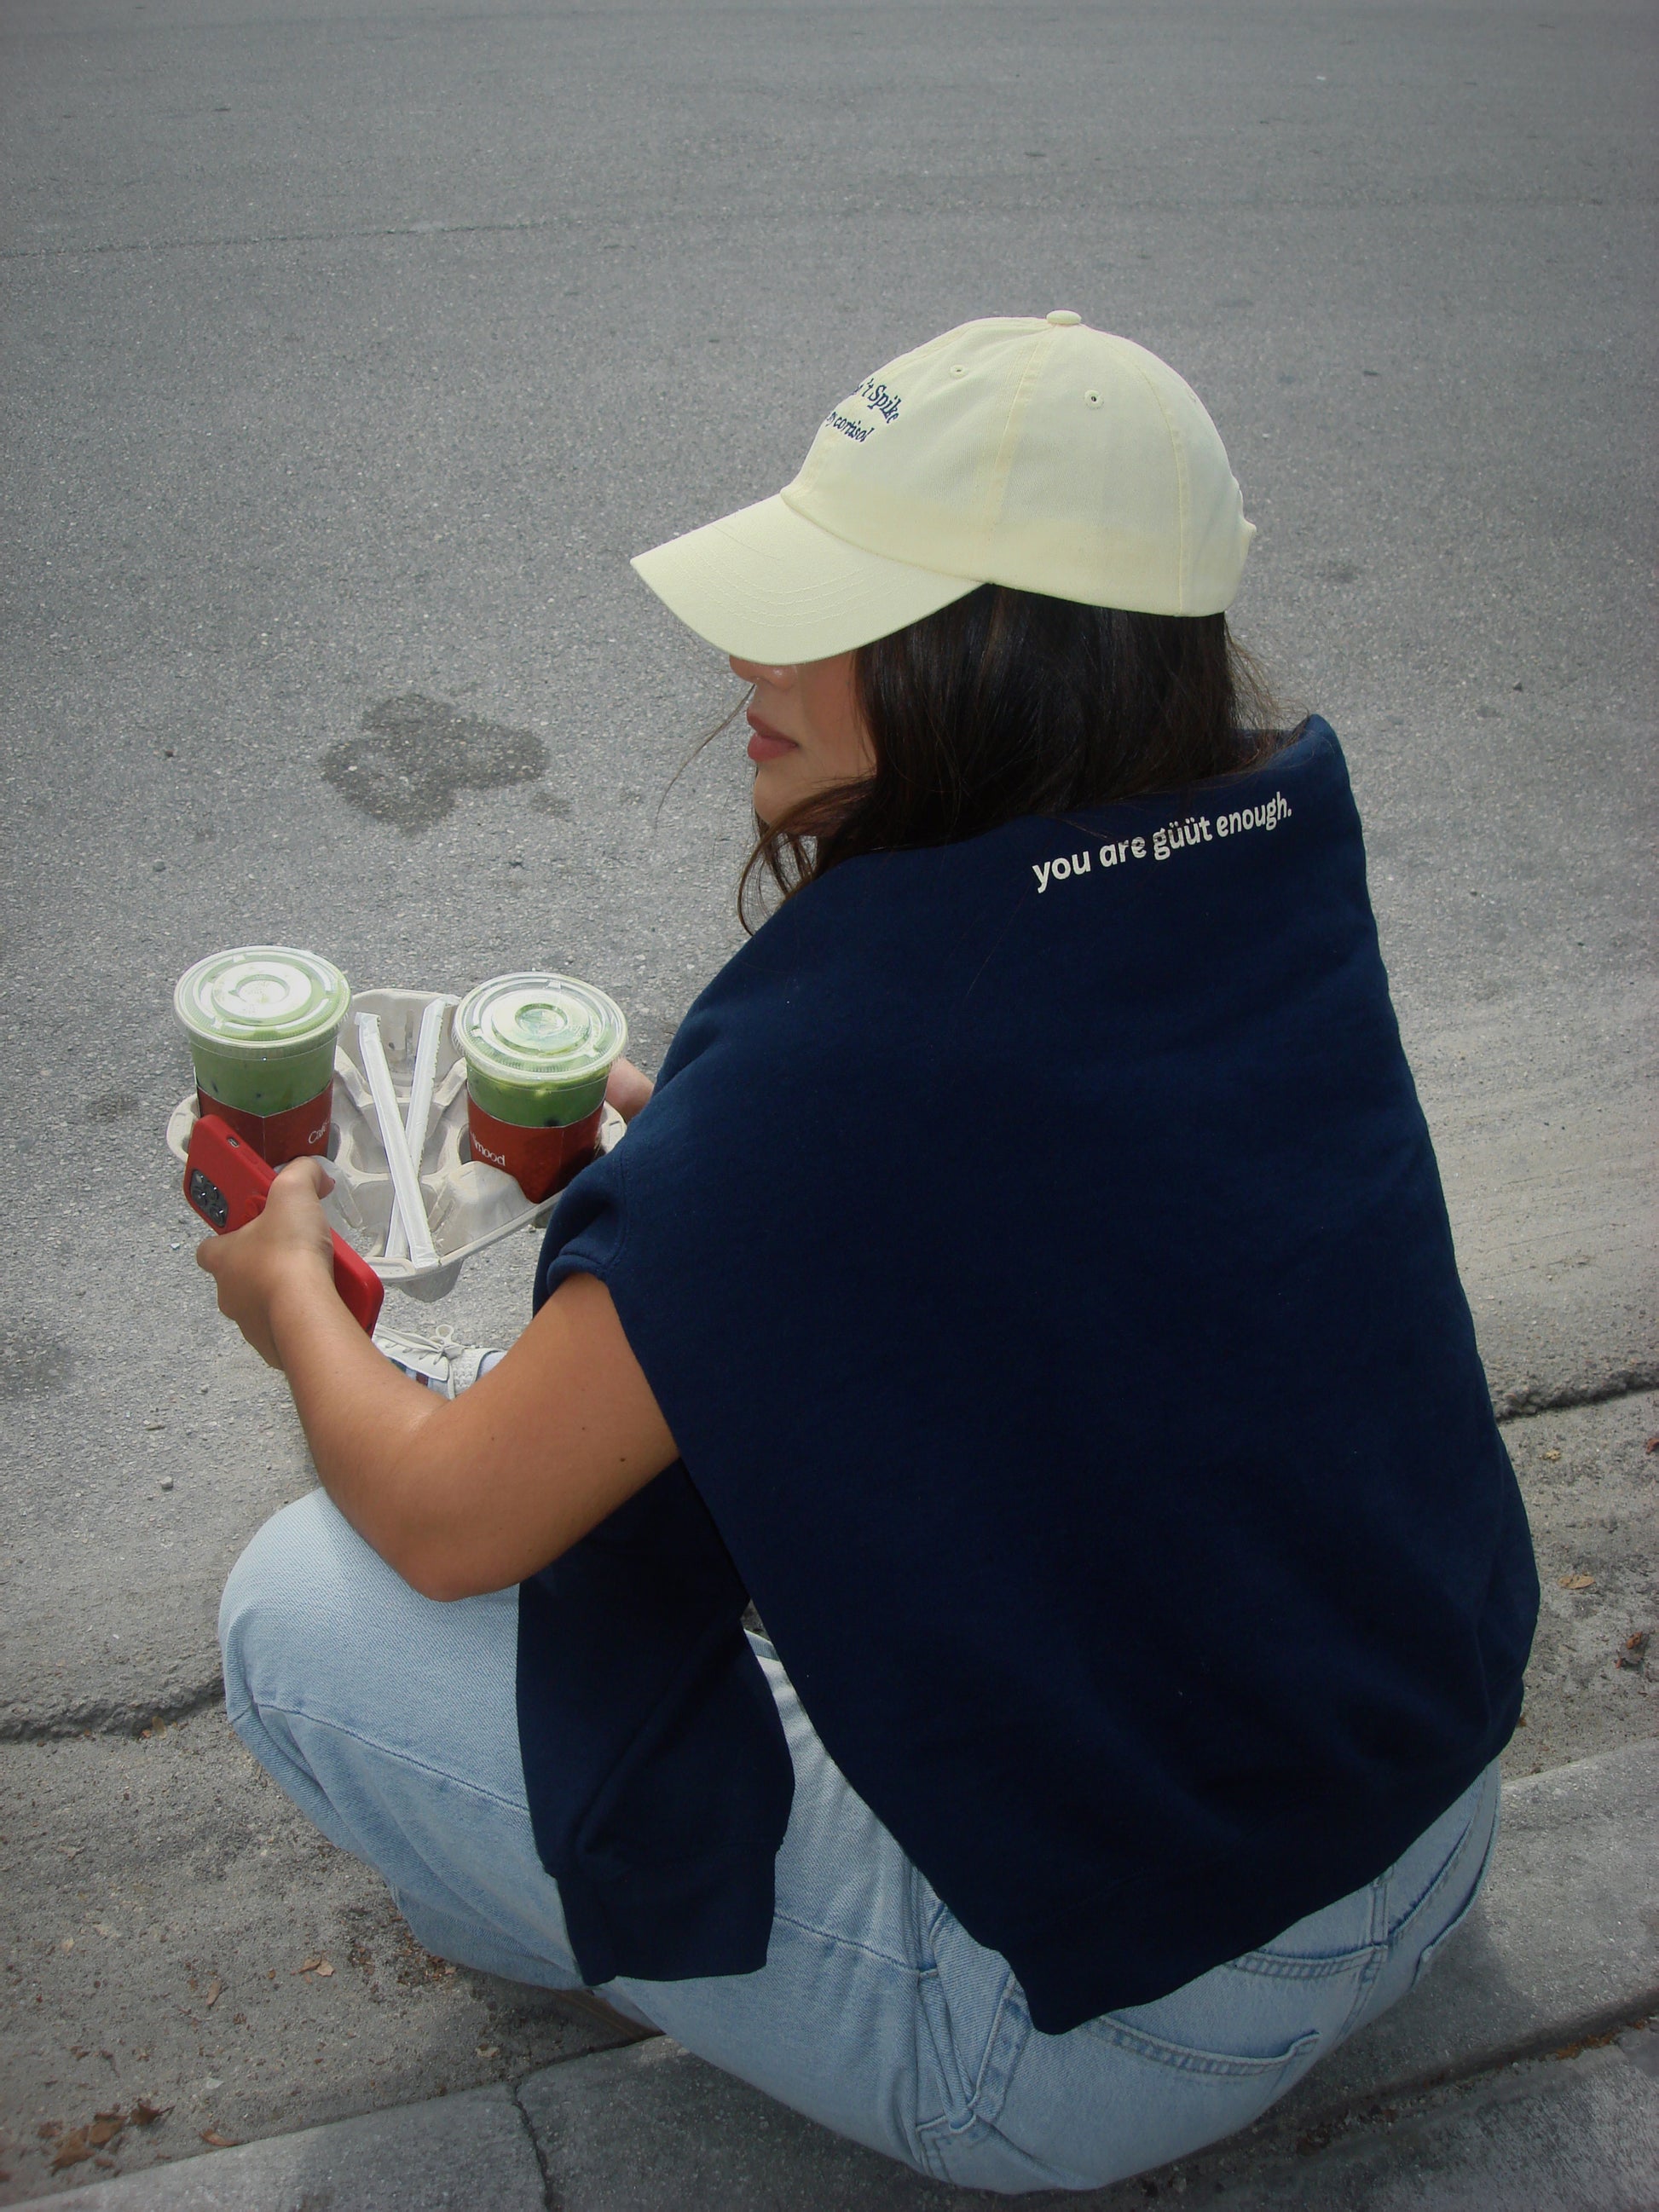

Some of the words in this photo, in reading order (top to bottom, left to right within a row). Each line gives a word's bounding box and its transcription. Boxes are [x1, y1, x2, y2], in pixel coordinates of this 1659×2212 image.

[867, 384, 902, 424] Spike
[833, 416, 875, 442] cortisol
[1032, 851, 1091, 893] you
[1100, 836, 1147, 868] are
[1153, 816, 1212, 861] güüt
[1216, 791, 1292, 838] enough.
